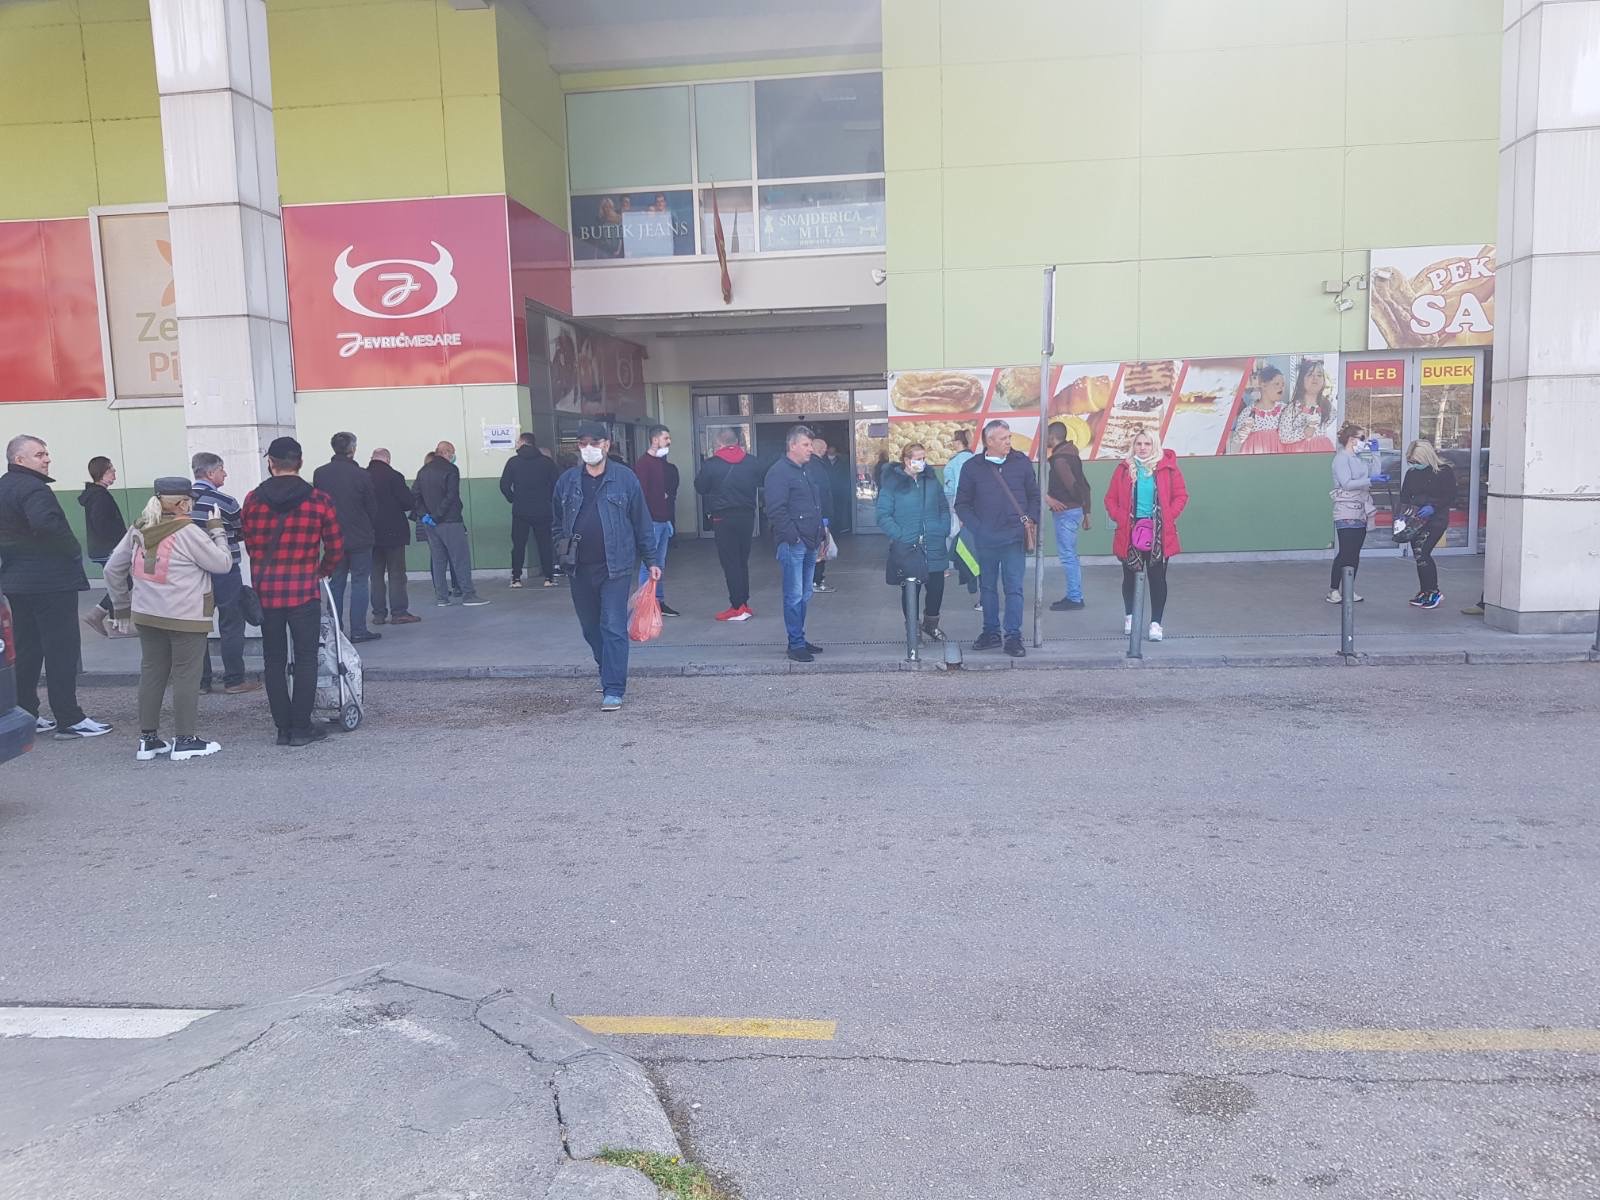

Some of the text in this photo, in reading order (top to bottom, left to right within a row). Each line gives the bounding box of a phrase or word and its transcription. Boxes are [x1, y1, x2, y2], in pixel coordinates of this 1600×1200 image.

[580, 221, 688, 240] BUTIK JEANS
[799, 225, 845, 239] MILA
[1410, 292, 1494, 335] SA
[1353, 367, 1397, 381] HLEB
[1423, 365, 1473, 378] BUREK
